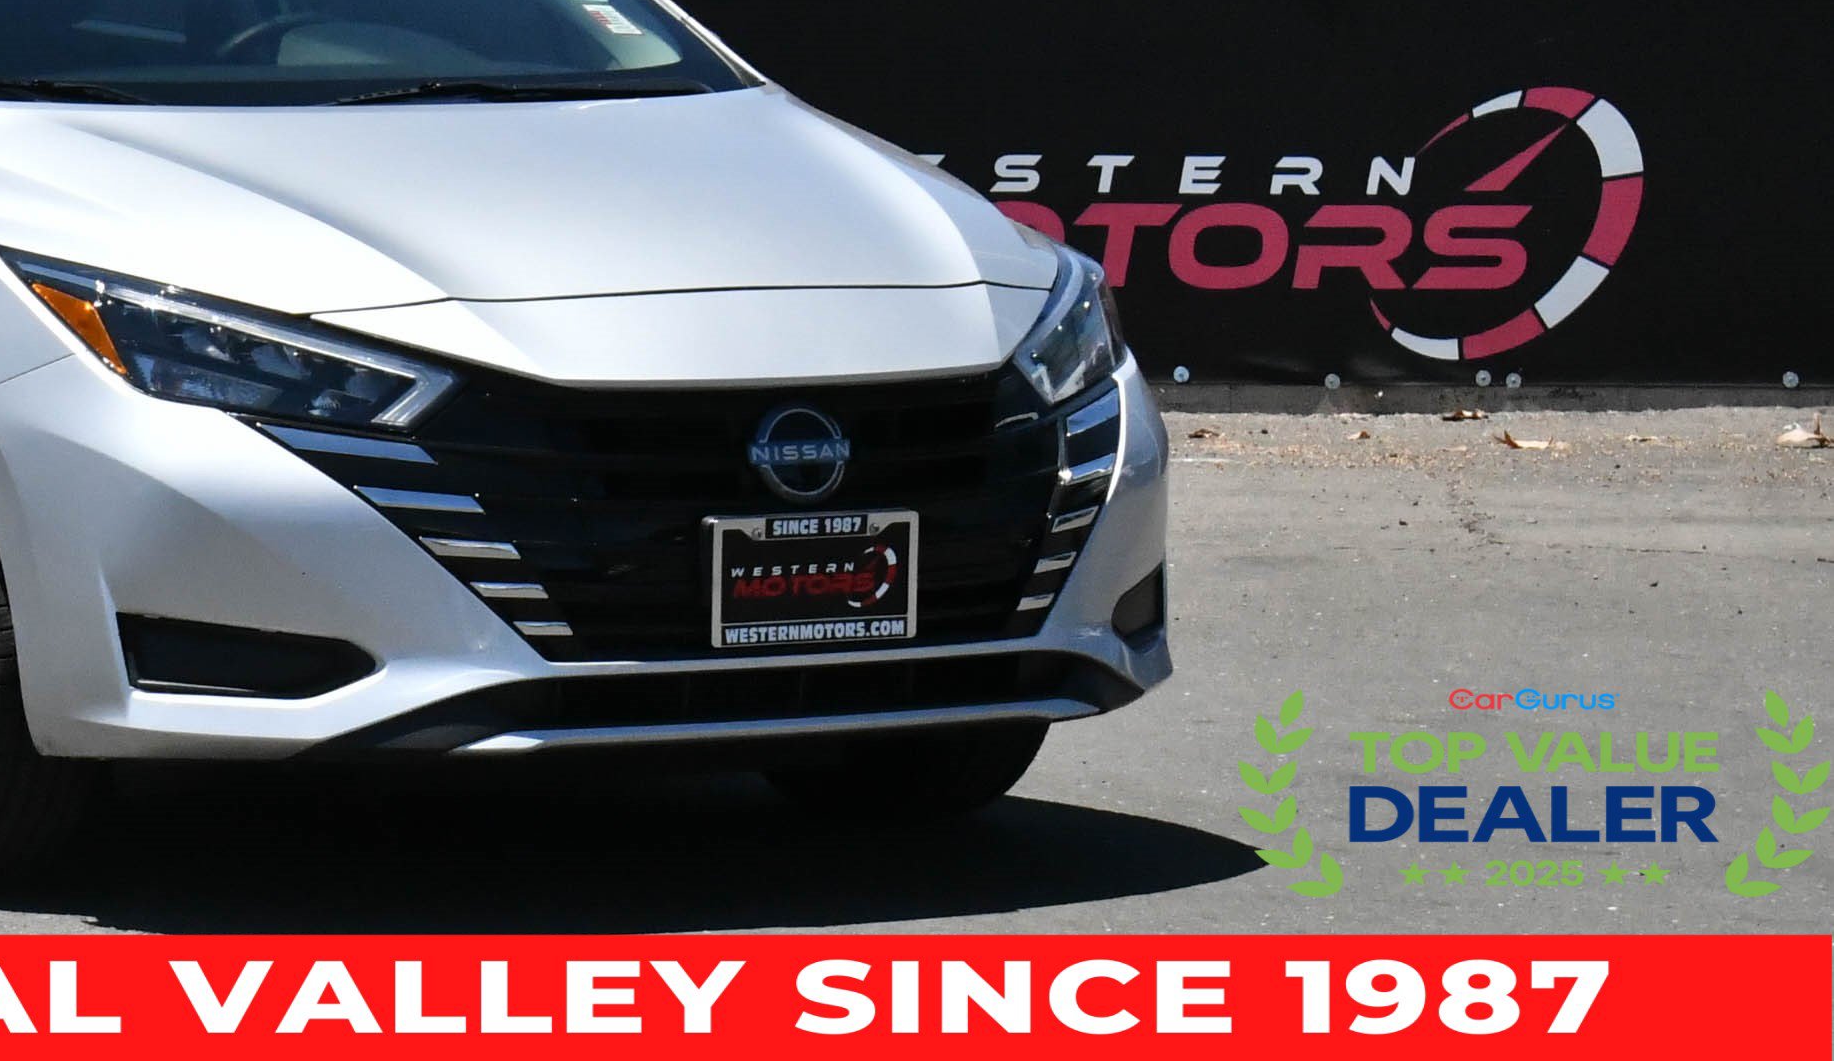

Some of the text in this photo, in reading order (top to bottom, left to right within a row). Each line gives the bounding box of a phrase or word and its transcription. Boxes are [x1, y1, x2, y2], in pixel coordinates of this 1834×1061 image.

[916, 154, 1416, 196] STERN
[993, 201, 1533, 290] TORS
[751, 442, 850, 461] NISSAN
[772, 517, 862, 535] SINCE 1987
[731, 562, 855, 578] WESTERN
[733, 572, 875, 599] MOTORS
[725, 620, 905, 643] WESTERNMOTORS.COM
